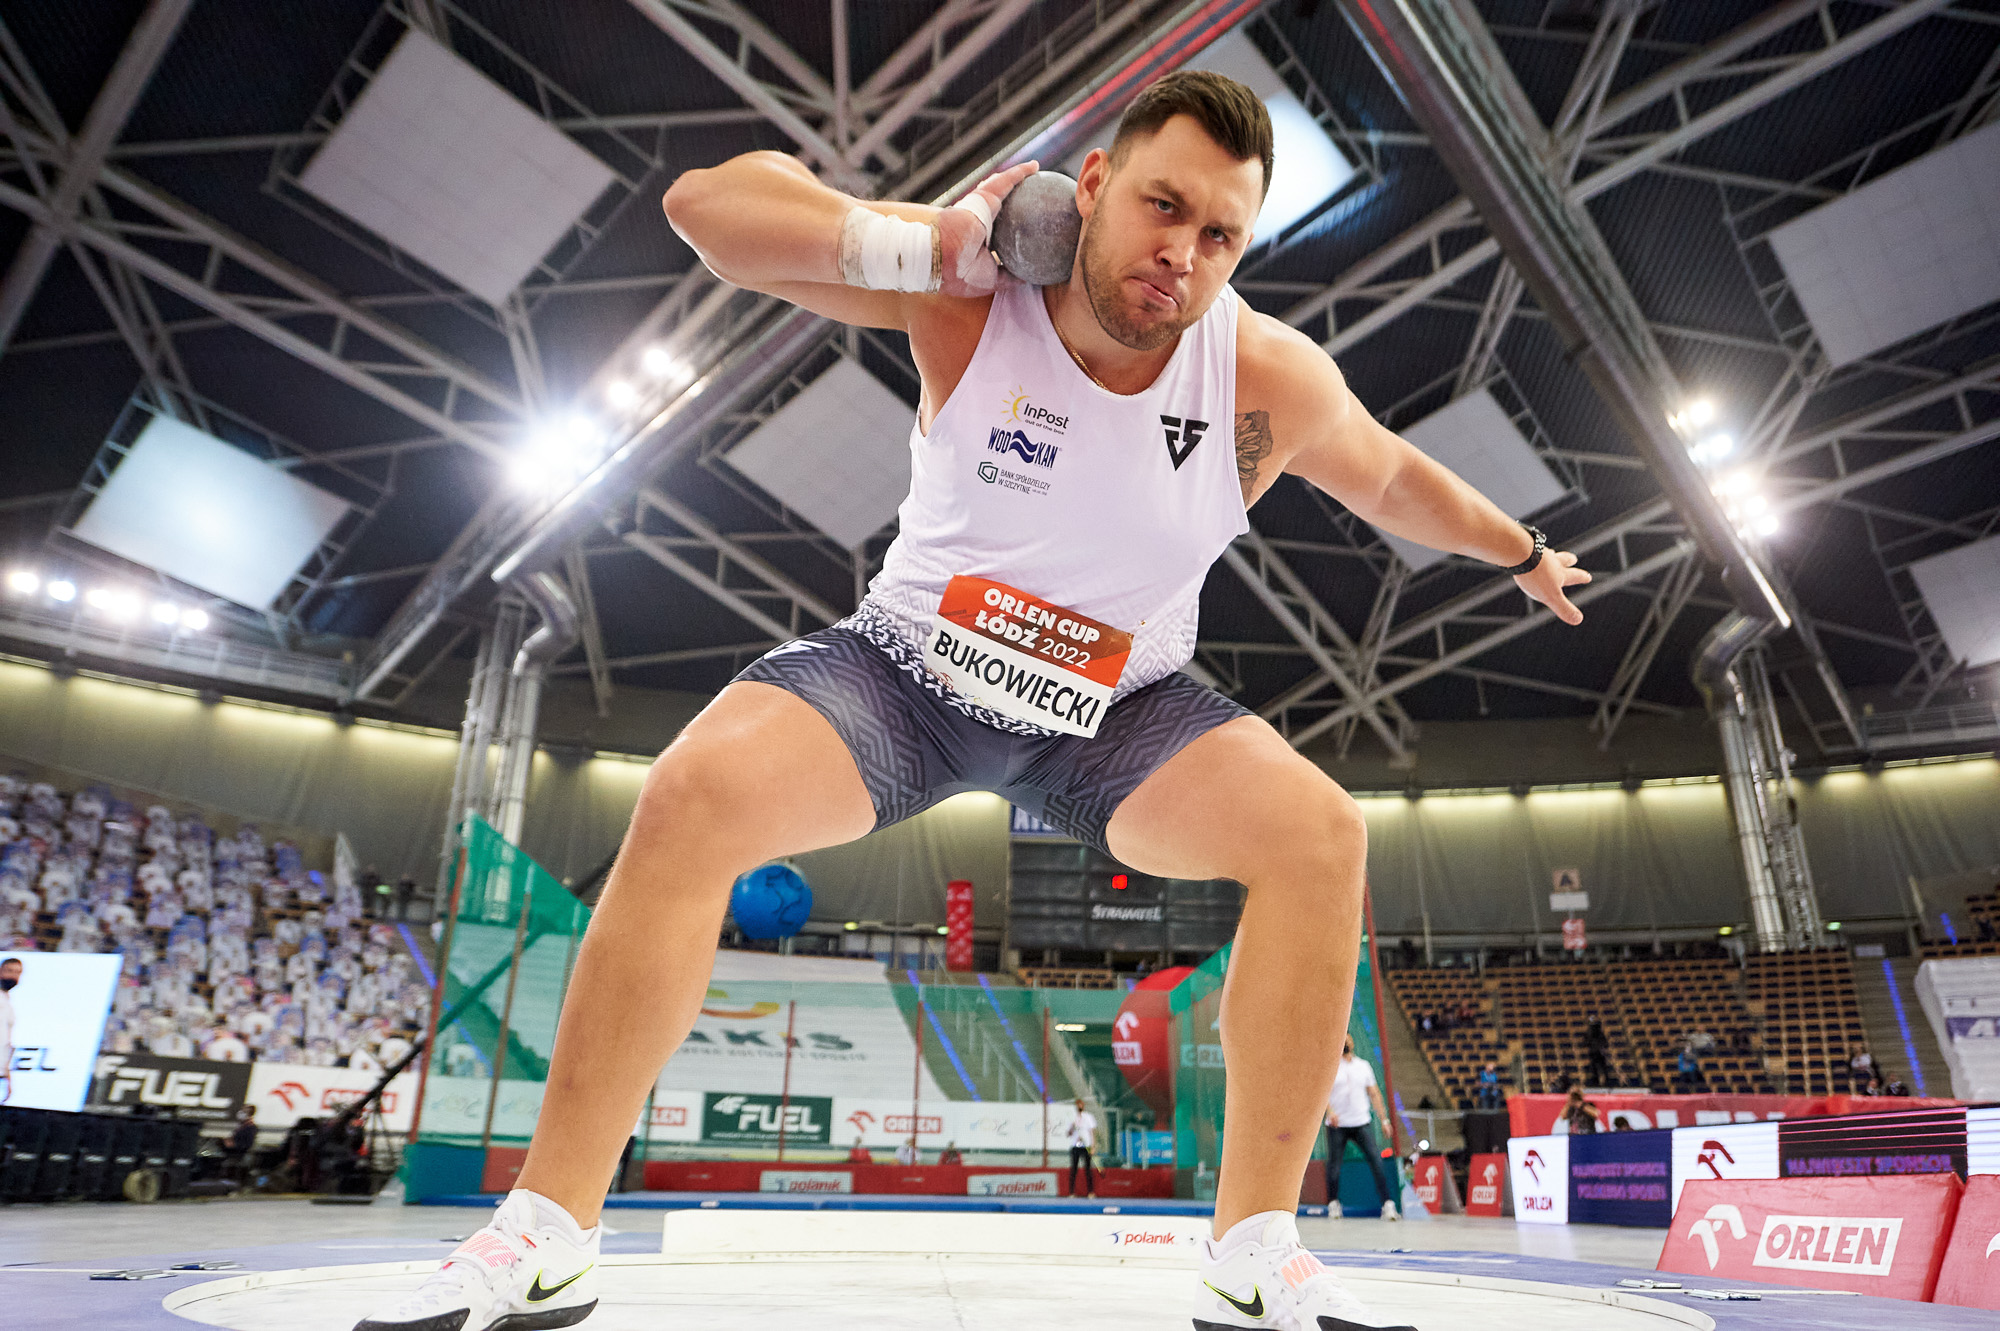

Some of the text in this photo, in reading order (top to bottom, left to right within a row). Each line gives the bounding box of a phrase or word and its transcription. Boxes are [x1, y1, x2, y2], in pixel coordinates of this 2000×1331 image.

[1024, 403, 1069, 429] InPost
[988, 427, 1058, 469] WOD KAN
[998, 478, 1004, 486] W
[1004, 480, 1032, 495] SZCZYTNIE
[1000, 469, 1051, 491] BANK SPÓŁDZIELCZY
[984, 588, 1100, 645] ORLEN CUP
[974, 610, 1091, 669] ŁÓDŹ 2022
[933, 630, 1100, 728] BUKOWIECKI
[108, 1066, 232, 1109] FUEL
[738, 1104, 822, 1132] FUEL
[1124, 1231, 1175, 1246] polanik
[1766, 1223, 1890, 1265] ORLEN
